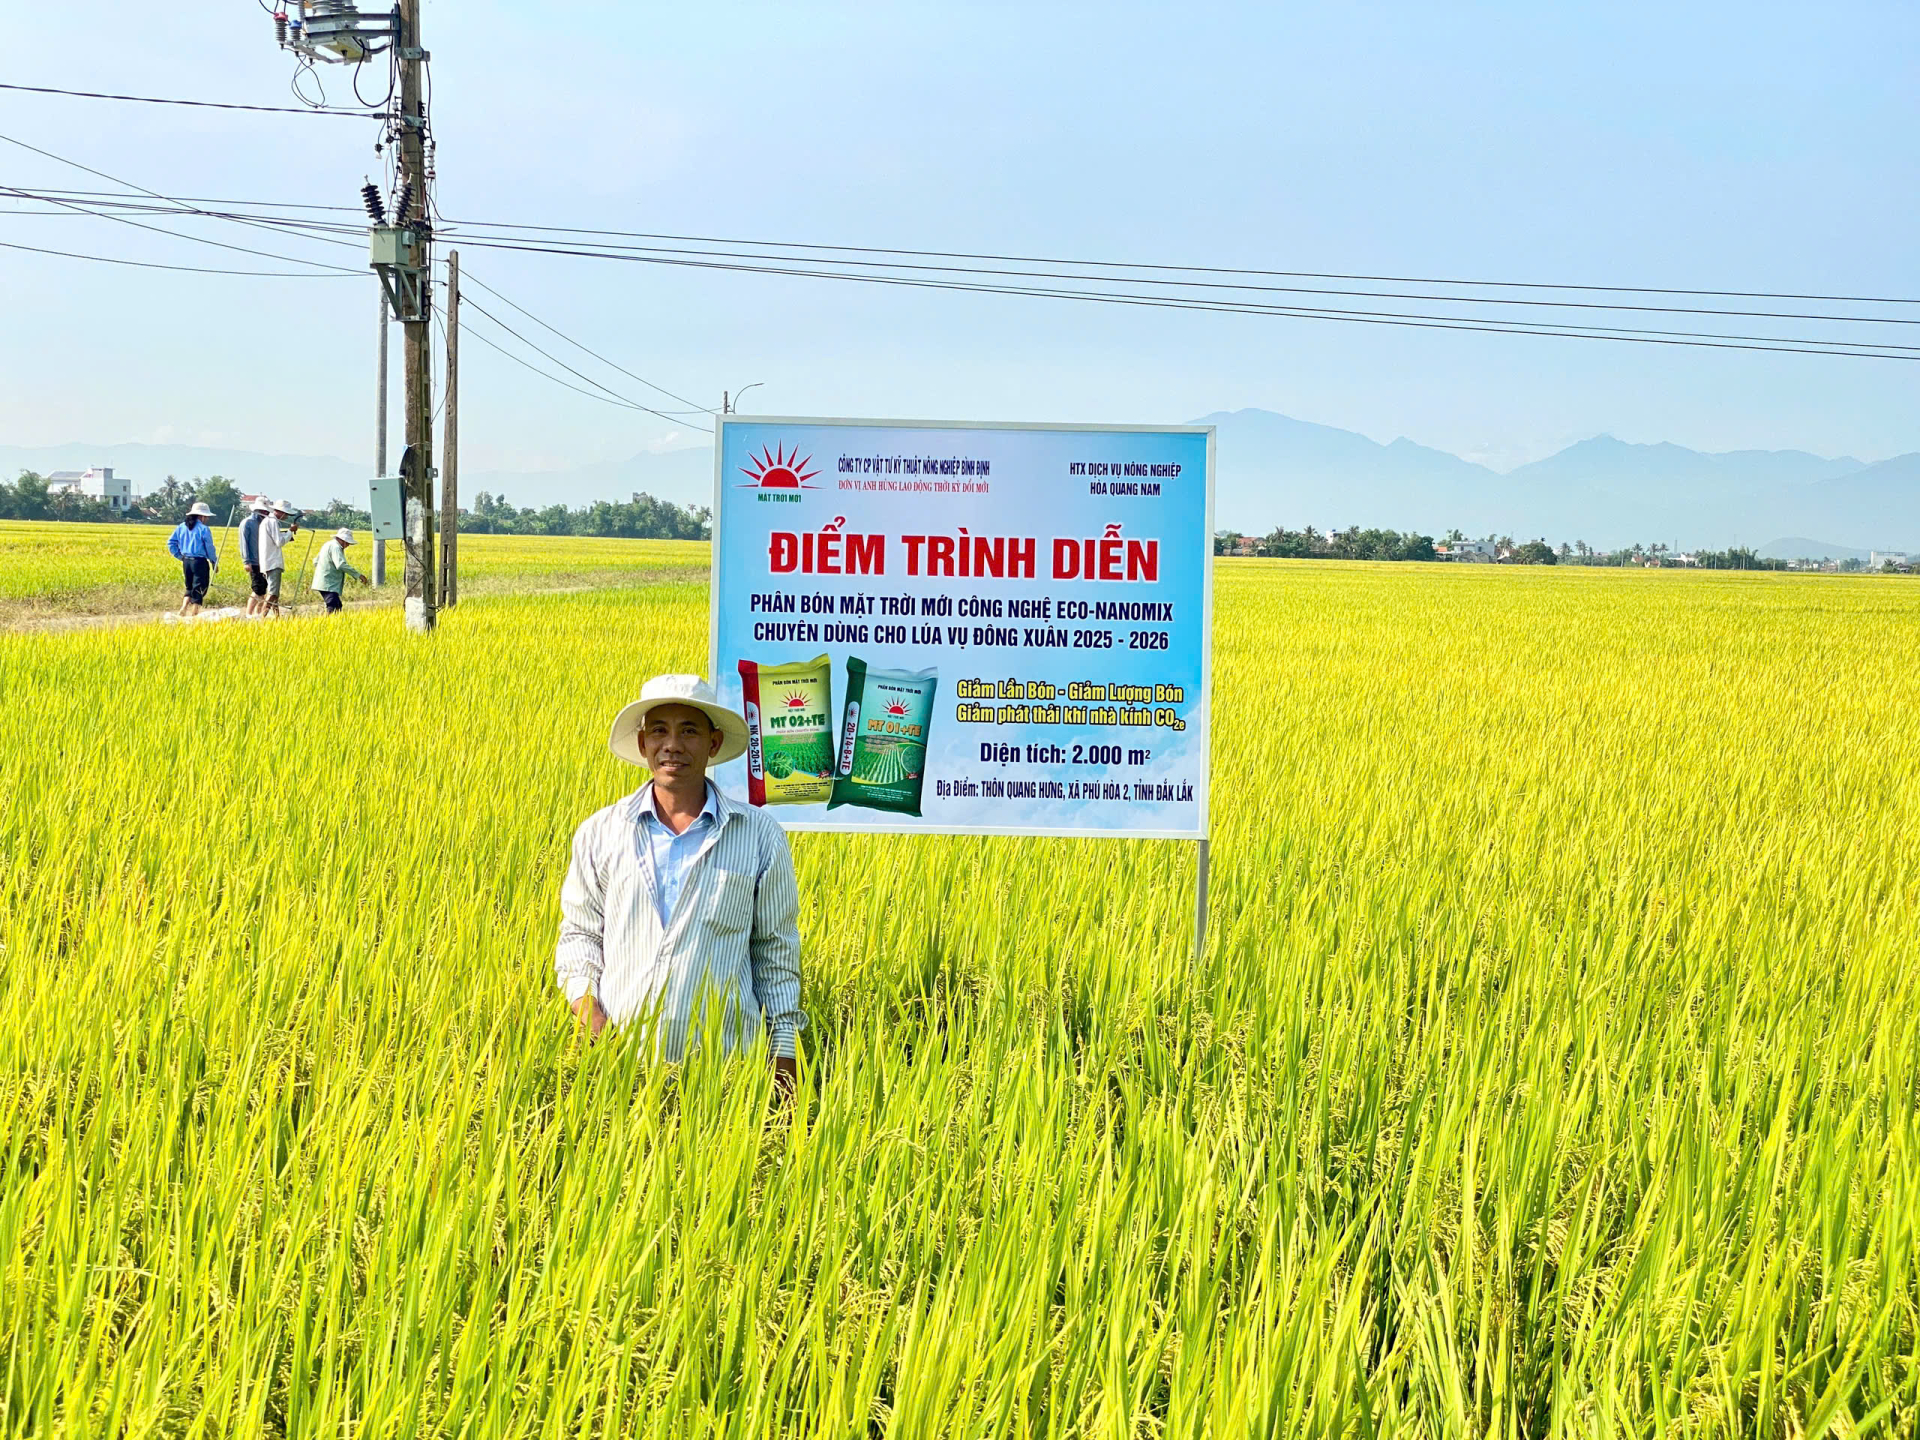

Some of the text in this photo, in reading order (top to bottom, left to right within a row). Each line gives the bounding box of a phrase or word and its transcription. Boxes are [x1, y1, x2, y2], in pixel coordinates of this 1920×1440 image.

[838, 453, 854, 472] CÔNG
[855, 458, 862, 473] TY
[864, 458, 872, 473] CP
[872, 454, 884, 476] VẬT
[885, 456, 893, 474] TƯ
[903, 455, 922, 477] THUẬT
[922, 455, 938, 474] NÔNG
[940, 456, 960, 478] NGHIỆP
[961, 456, 975, 476] BÌNH
[976, 460, 990, 479] ĐỊNH
[1070, 461, 1182, 480] HTX DỊCH VỤ NÔNG NGHIỆP
[838, 479, 852, 490] ĐƠN
[854, 480, 860, 492] VỊ
[863, 481, 876, 491] ANH
[878, 478, 898, 492] HÙNG
[899, 481, 912, 492] LAO
[914, 480, 932, 494] ĐỘNG
[934, 480, 950, 492] THỜI
[962, 478, 974, 493] ĐỔI
[976, 480, 989, 493] MỚI
[1090, 479, 1160, 496] HÒA QUANG NAM
[769, 516, 1159, 582] ĐIỂM TRÌNH DIỄN
[750, 591, 1173, 622] PHÂN BÓN MẶT TRỜI MỚI CÔNG NGHỆ ECO-NANOMIX
[754, 620, 818, 642] CHUYÊN
[824, 620, 868, 643] DÙNG
[874, 625, 906, 644] CHO
[912, 623, 942, 645] LÚA
[948, 627, 967, 649] VỤ
[973, 624, 1018, 646] ĐÔNG
[1023, 625, 1068, 647] XUÂN
[1073, 630, 1112, 648] 2025
[1129, 631, 1169, 650] 2026
[957, 678, 995, 698] Giảm
[998, 678, 1024, 699] Lần
[1027, 681, 1055, 700] Bón
[1068, 680, 1106, 701] Giảm
[1109, 683, 1152, 705] Lượng
[1155, 684, 1184, 703] Bón
[770, 714, 825, 728] MT 02+TE
[868, 719, 885, 732] MT
[956, 702, 995, 723] Giảm
[997, 704, 1030, 725] phát
[1032, 703, 1060, 724] thải
[1063, 706, 1087, 724] khí
[1090, 707, 1117, 725] nhà
[1120, 707, 1152, 725] kính
[750, 724, 761, 772] NK 20-20+TE
[842, 722, 856, 770] 20-14-8+TE
[980, 743, 1020, 767] Diện
[1027, 743, 1066, 764] tích:
[1072, 745, 1122, 765] 2.000
[937, 780, 951, 800] Địa
[954, 776, 978, 797] Điểm:
[981, 777, 1004, 798] THÔN
[1007, 781, 1036, 799] QUANG
[1039, 780, 1065, 801] HƯNG,
[1068, 780, 1080, 799] XÃ
[1083, 780, 1100, 800] PHÚ
[1103, 780, 1120, 800] HÒA
[1123, 784, 1131, 802] 2,
[1134, 778, 1153, 800] TỈNH
[1156, 778, 1174, 801] ĐẮK
[1177, 779, 1193, 802] LẮK
